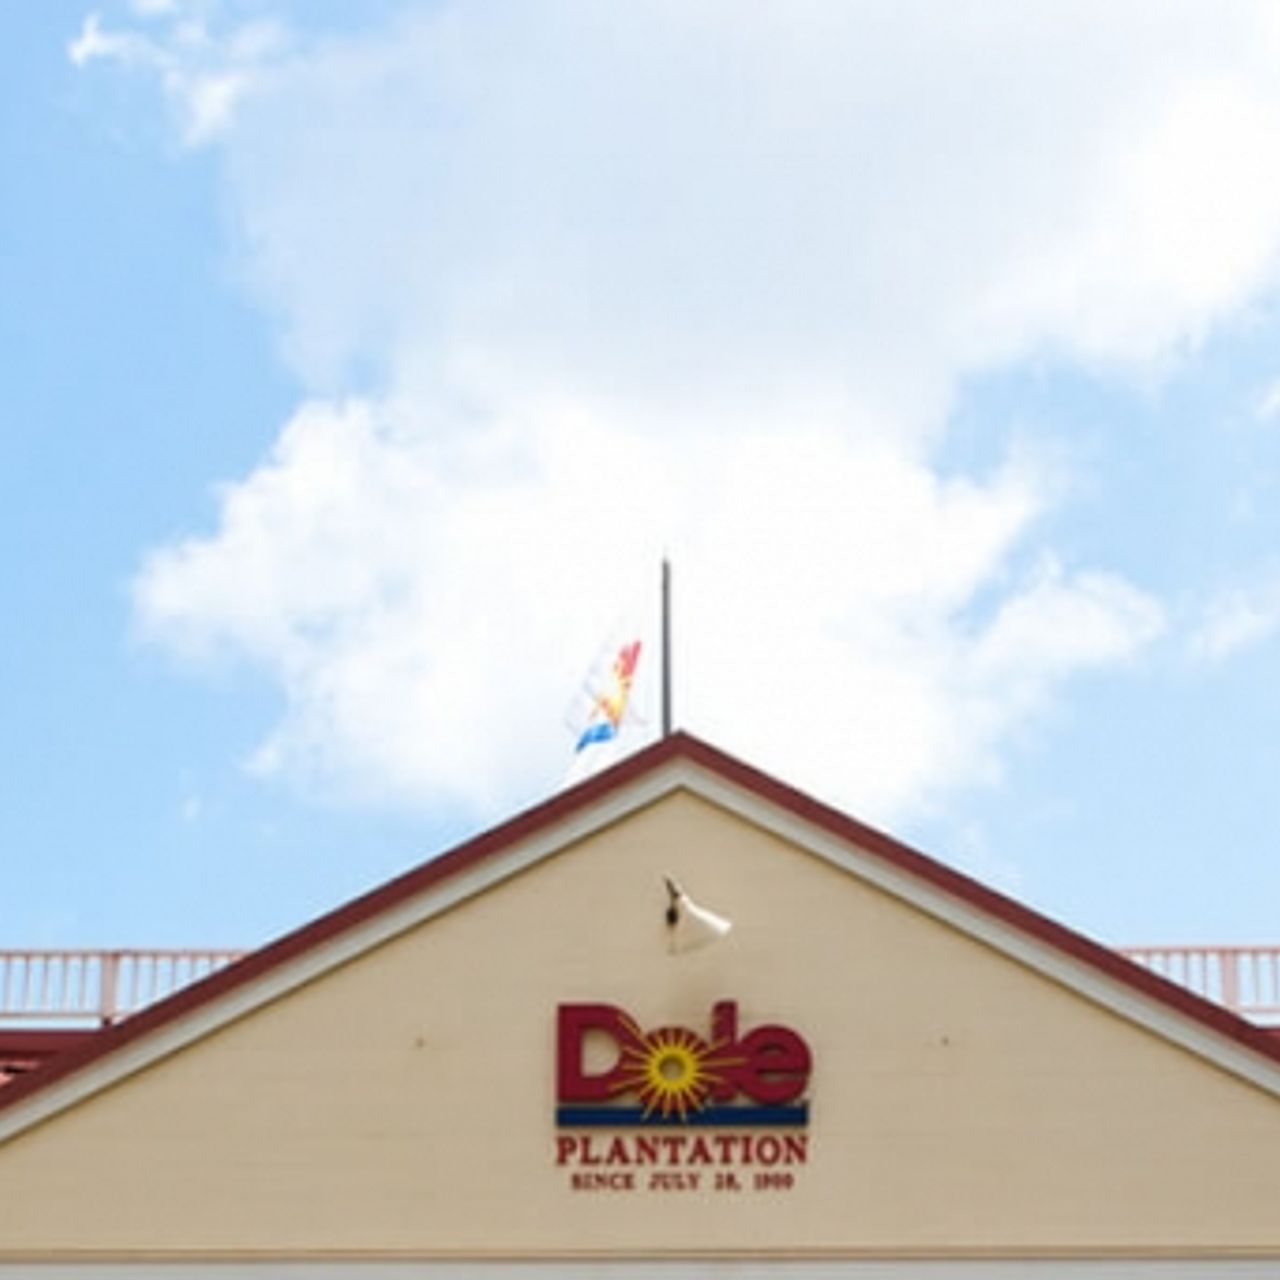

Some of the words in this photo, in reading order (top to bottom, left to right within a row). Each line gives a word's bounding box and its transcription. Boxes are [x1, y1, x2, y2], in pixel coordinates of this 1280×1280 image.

[555, 999, 814, 1106] Dole
[554, 1133, 810, 1168] PLANTATION
[570, 1172, 636, 1192] SINCE
[648, 1172, 702, 1192] JULY
